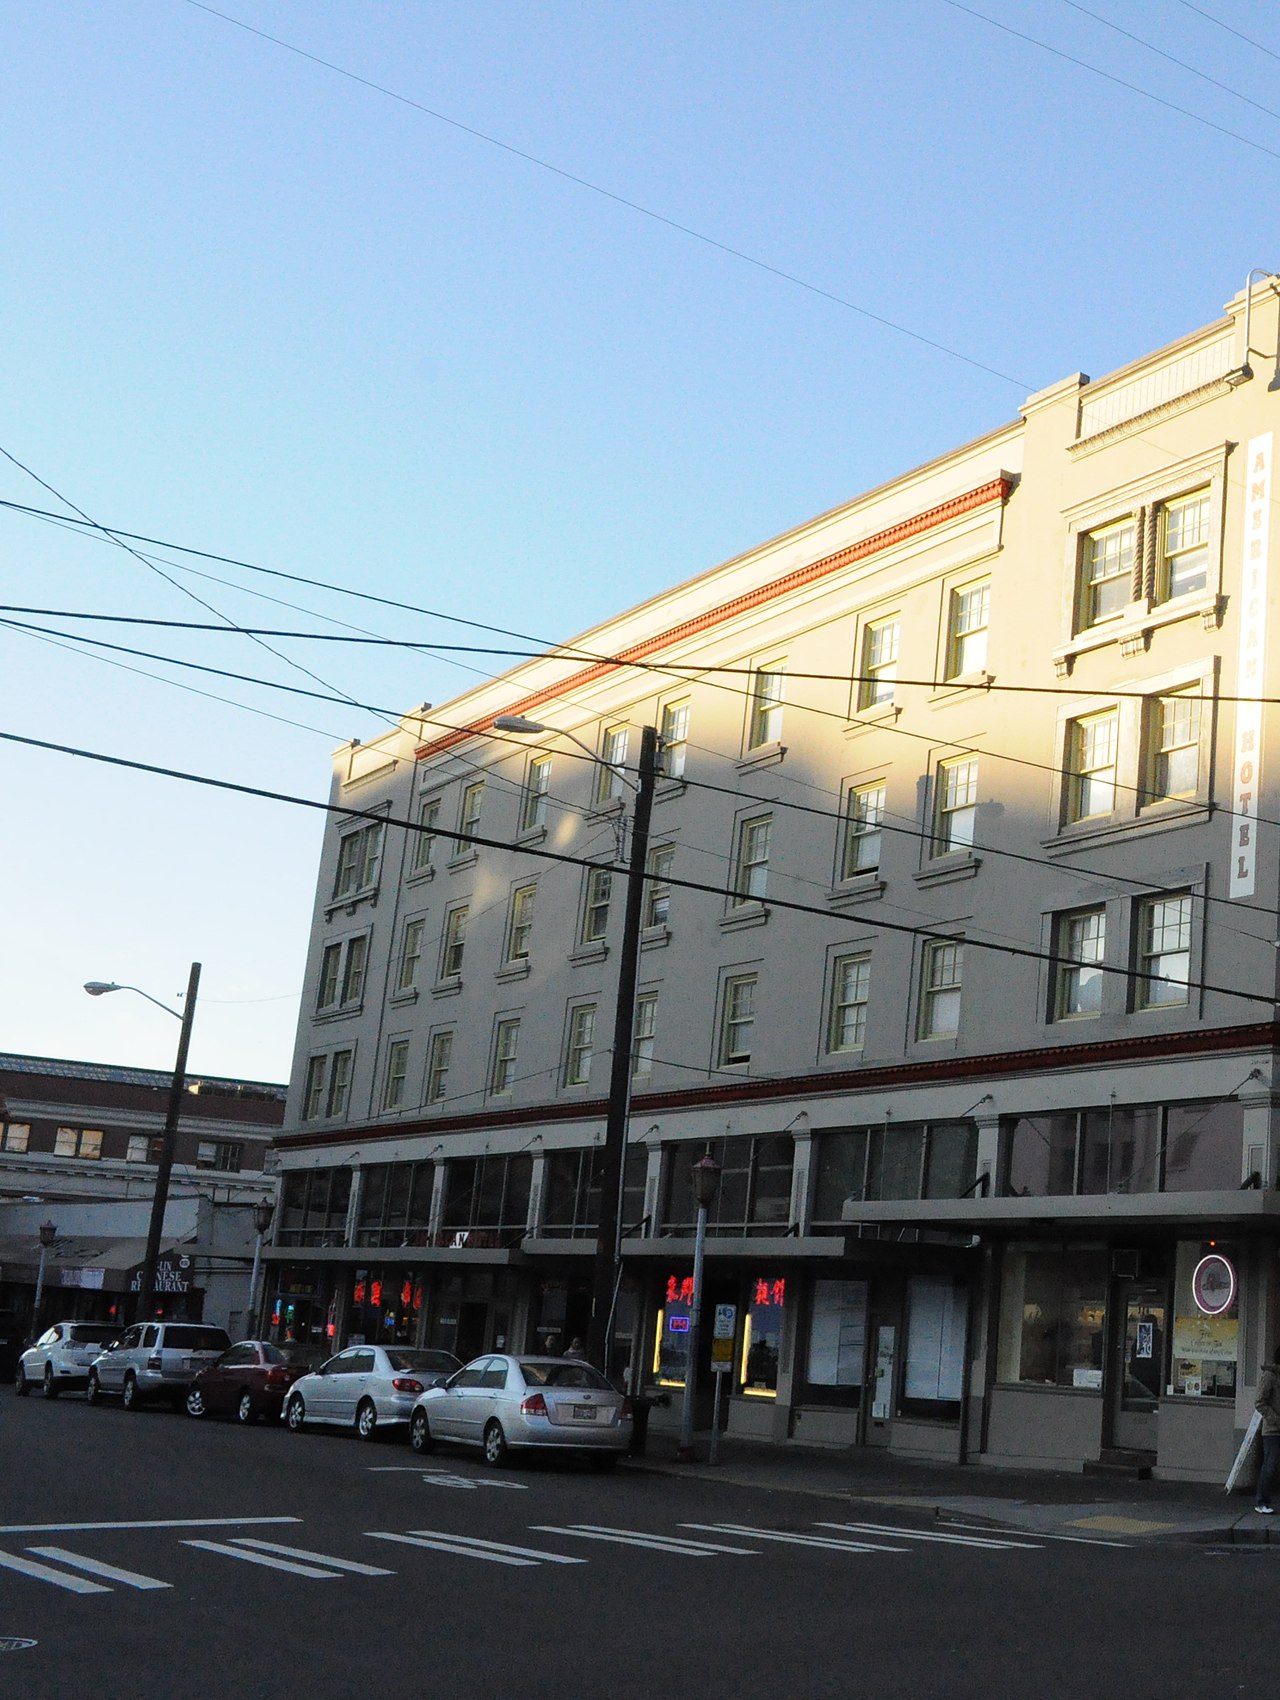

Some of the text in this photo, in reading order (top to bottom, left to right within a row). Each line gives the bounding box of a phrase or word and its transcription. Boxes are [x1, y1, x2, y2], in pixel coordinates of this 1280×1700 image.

[1238, 452, 1265, 879] AMERICAN HOTEL
[136, 1271, 182, 1282] CNESE
[130, 1281, 190, 1292] REAURANT
